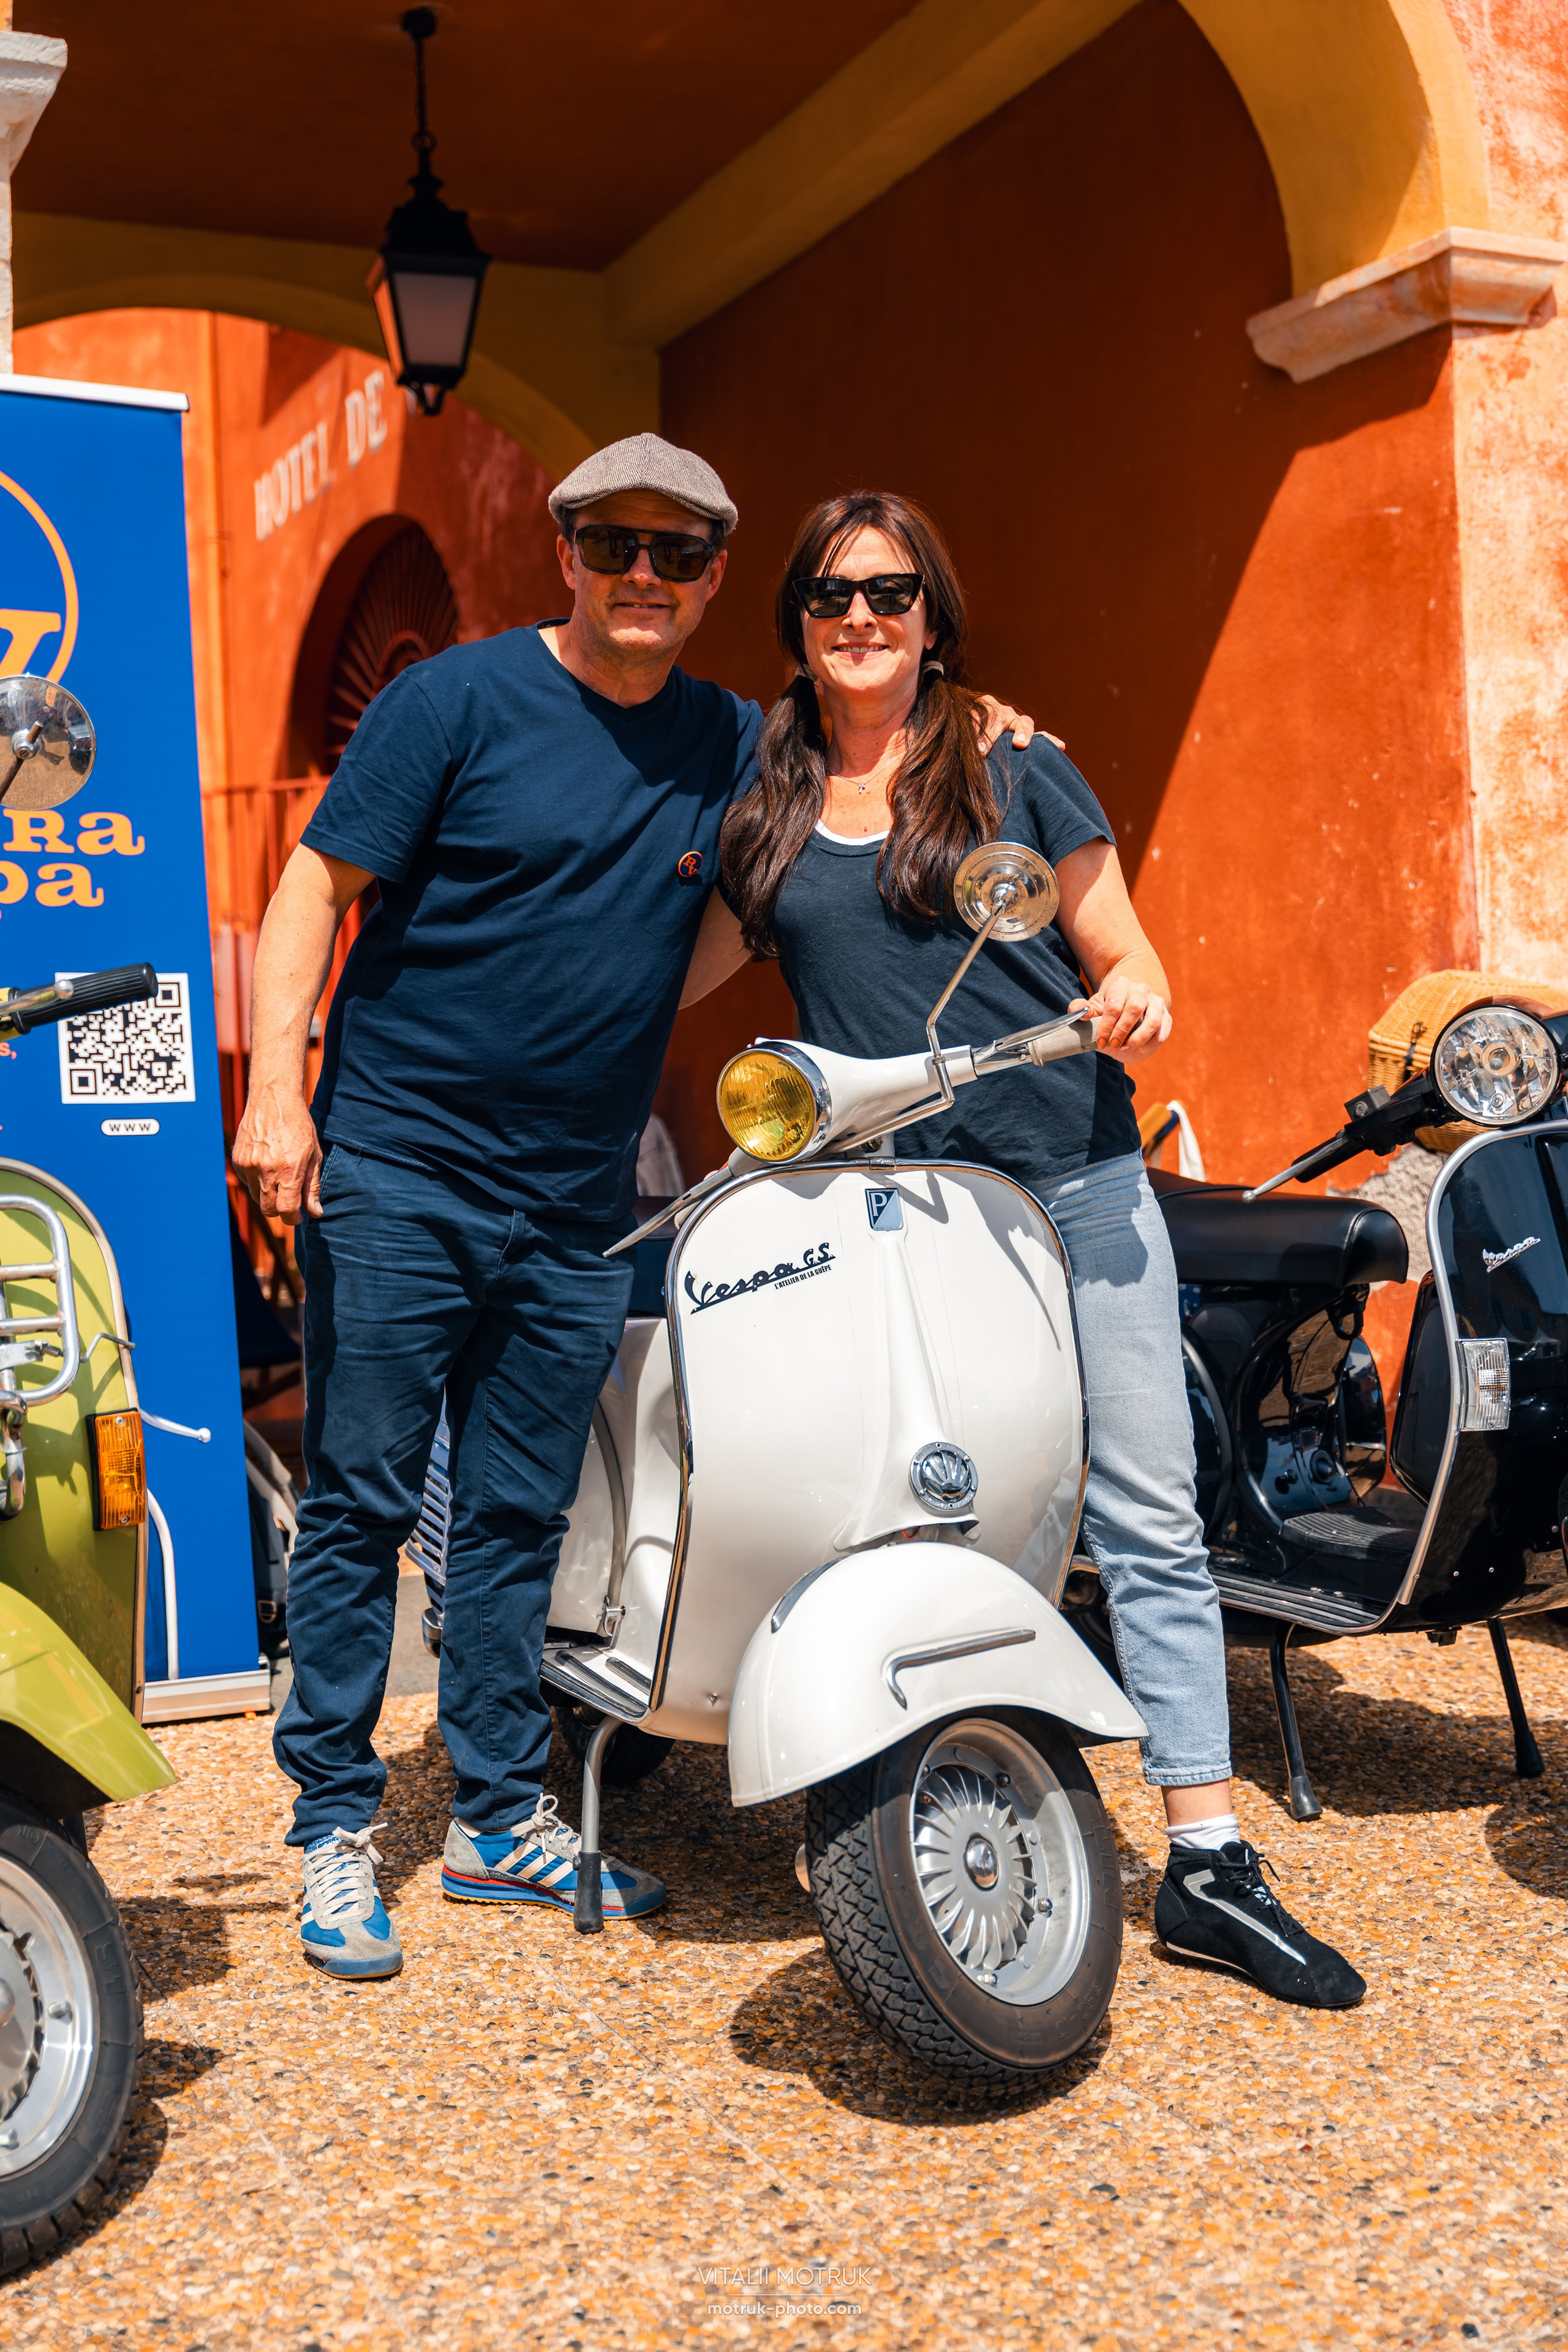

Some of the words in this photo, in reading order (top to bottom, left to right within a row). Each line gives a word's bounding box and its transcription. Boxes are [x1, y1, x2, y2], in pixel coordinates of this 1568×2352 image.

[345, 369, 388, 472] DE
[684, 1263, 801, 1313] Vespa
[774, 1276, 800, 1290] L'ATELIER
[815, 1264, 832, 1275] GUÊPE
